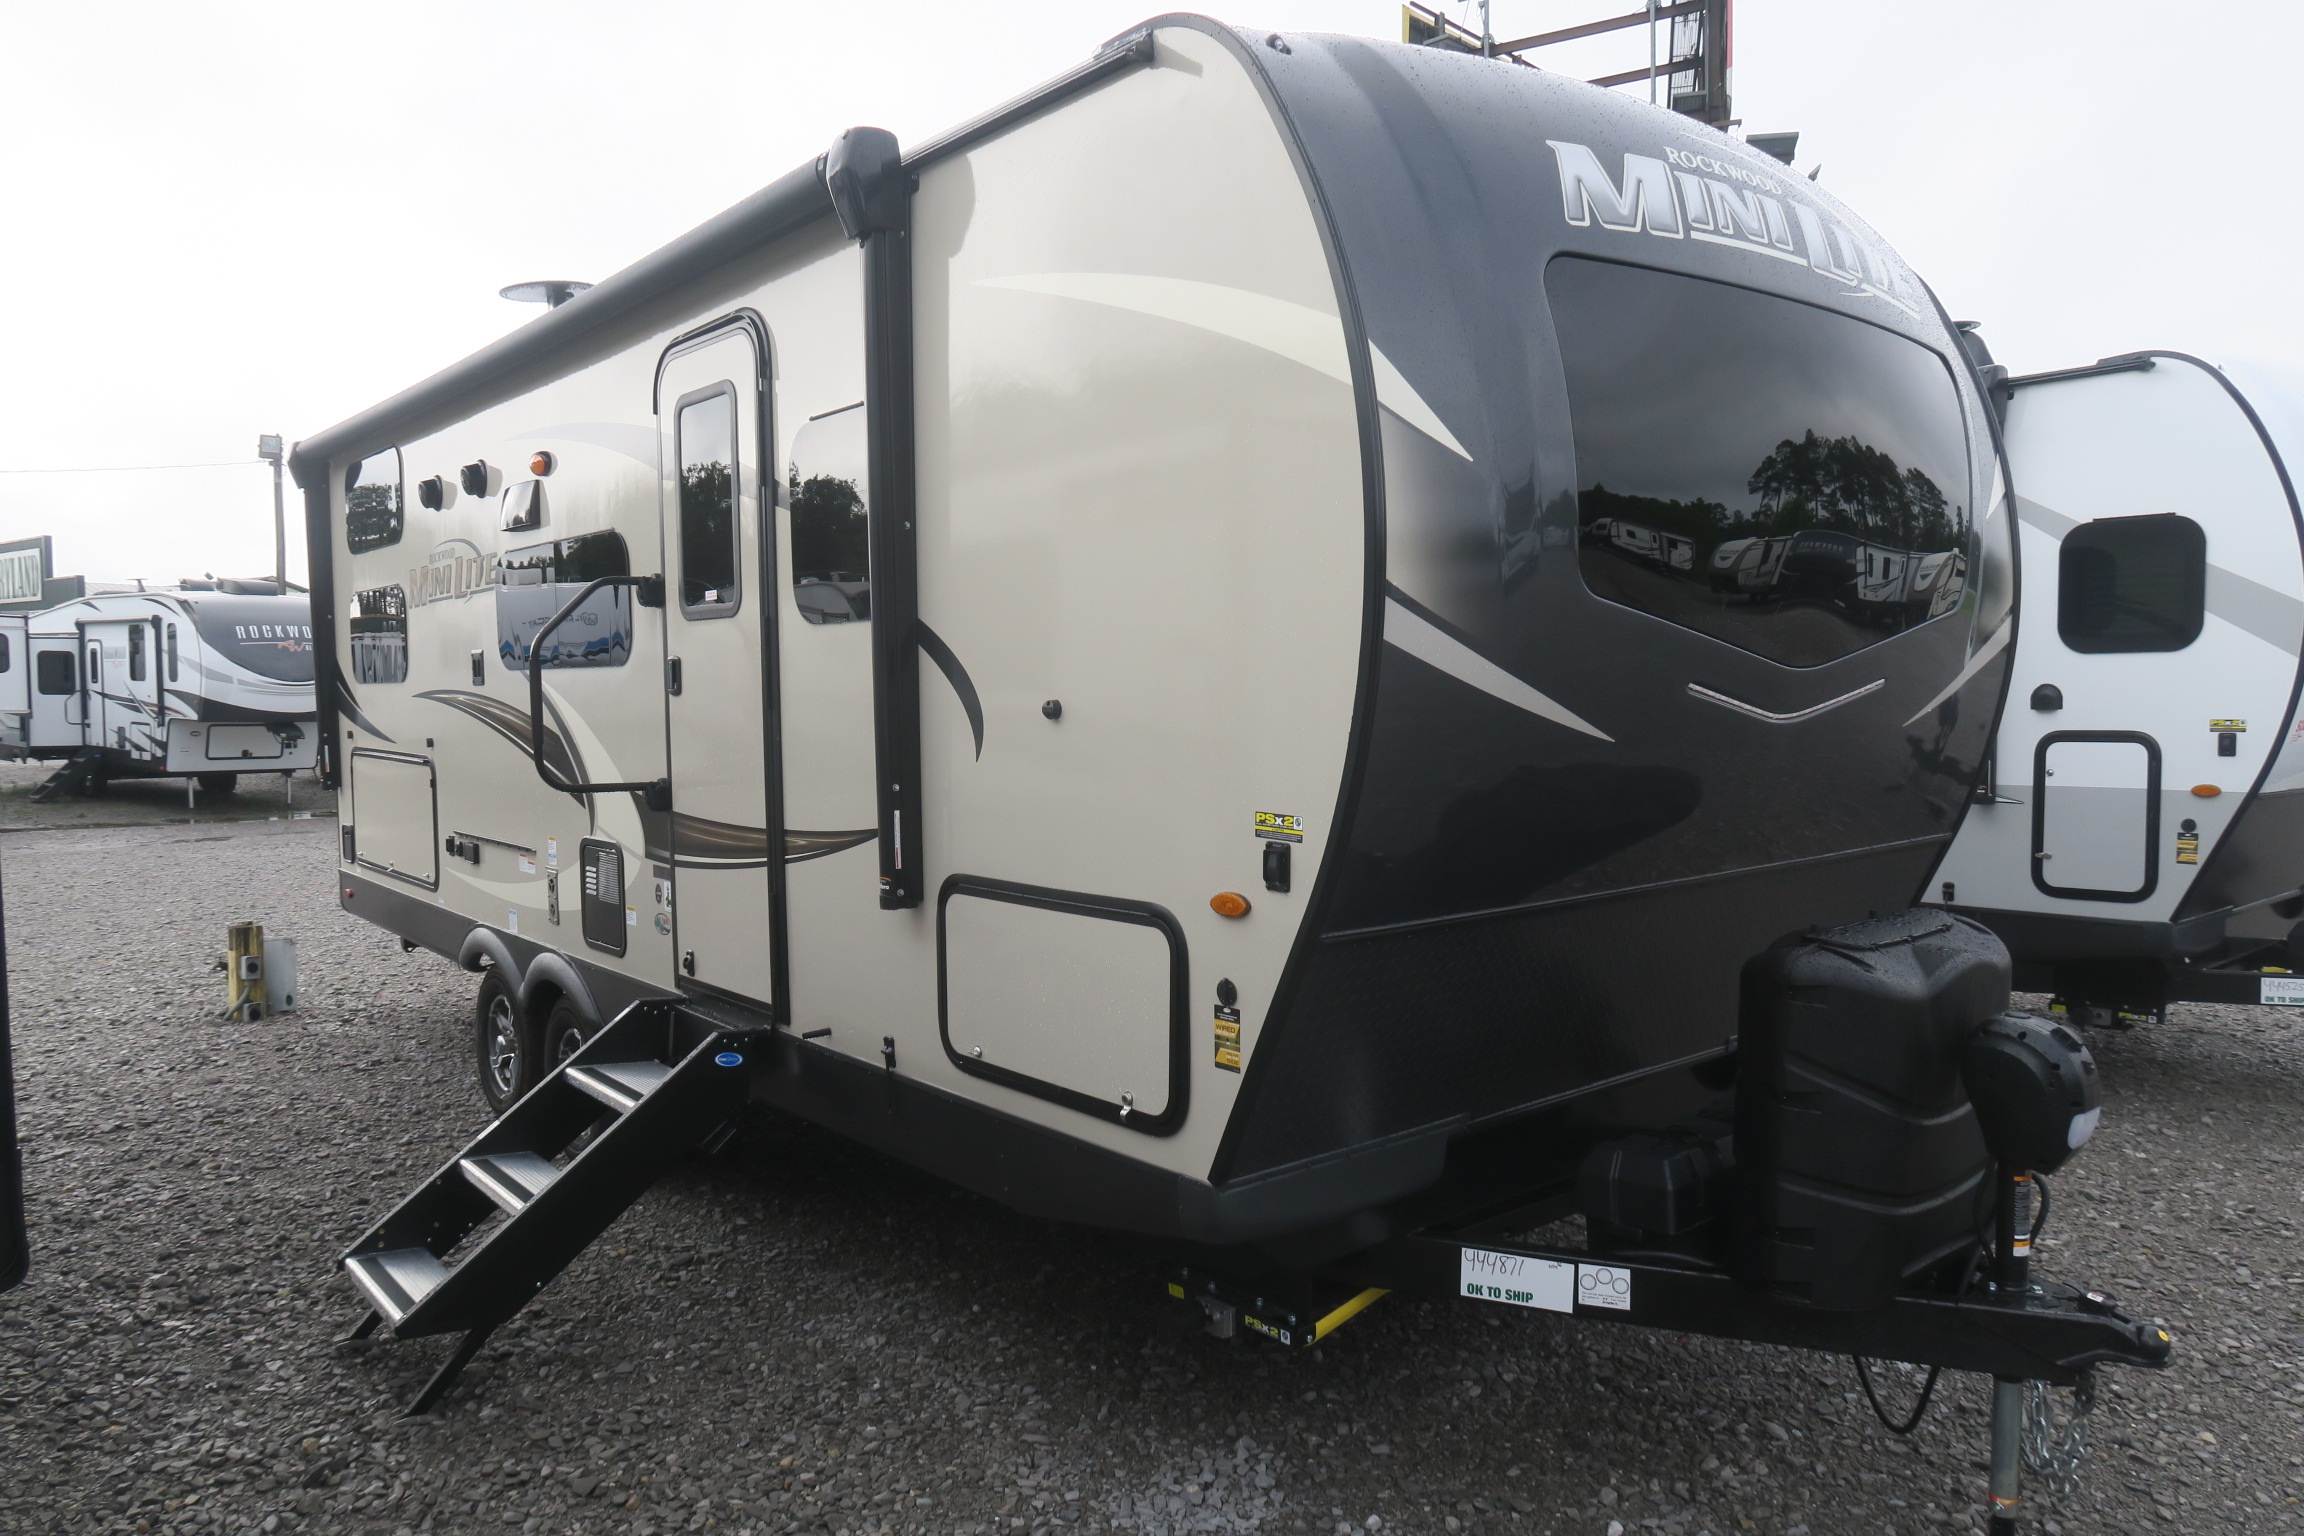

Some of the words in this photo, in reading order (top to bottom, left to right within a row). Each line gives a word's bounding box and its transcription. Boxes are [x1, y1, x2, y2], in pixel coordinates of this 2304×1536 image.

[1663, 146, 1782, 194] ROCKWOOD
[1256, 812, 1294, 827] PSx2
[1215, 1024, 1236, 1034] WIRED
[1466, 1283, 1484, 1297] OK
[1487, 1286, 1501, 1299] TO
[1505, 1290, 1534, 1304] SHIP
[1244, 1315, 1279, 1336] PSx2
